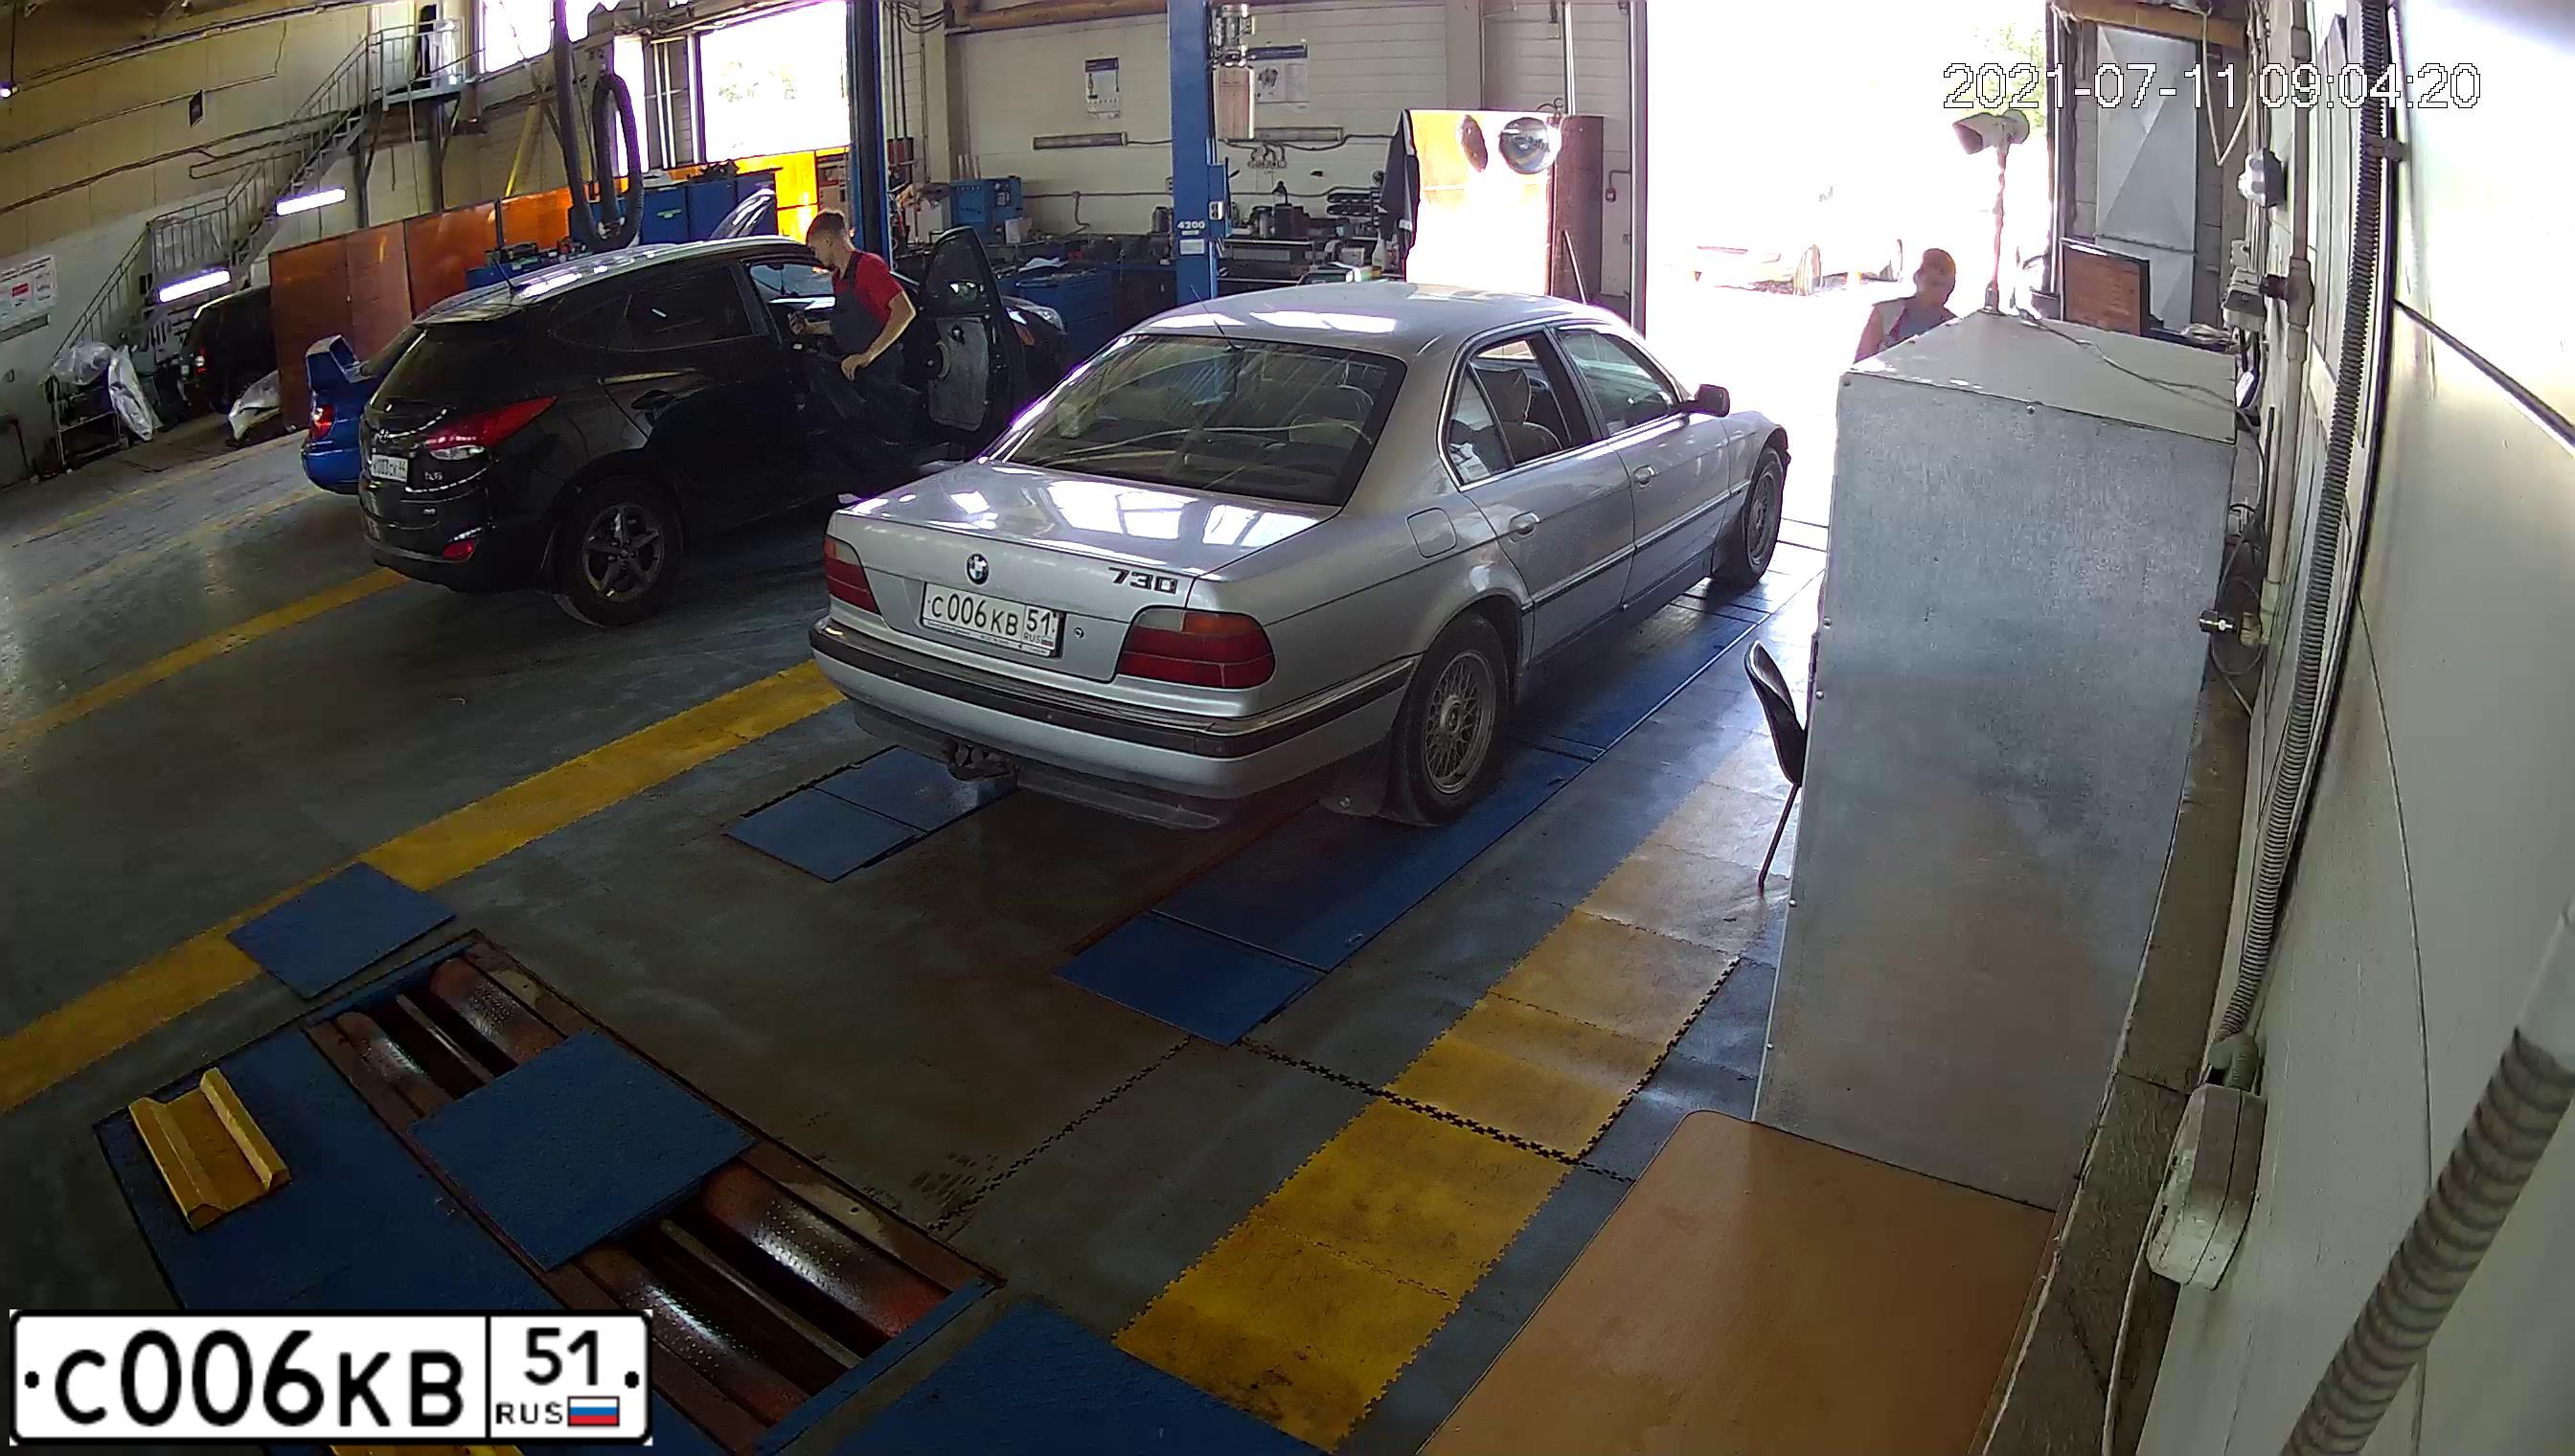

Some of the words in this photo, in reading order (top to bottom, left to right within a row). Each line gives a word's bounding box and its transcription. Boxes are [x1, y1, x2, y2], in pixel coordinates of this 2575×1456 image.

[1177, 220, 1206, 230] 4200
[1108, 566, 1178, 595] 730
[1026, 608, 1052, 636] 51
[1023, 632, 1041, 645] RUS
